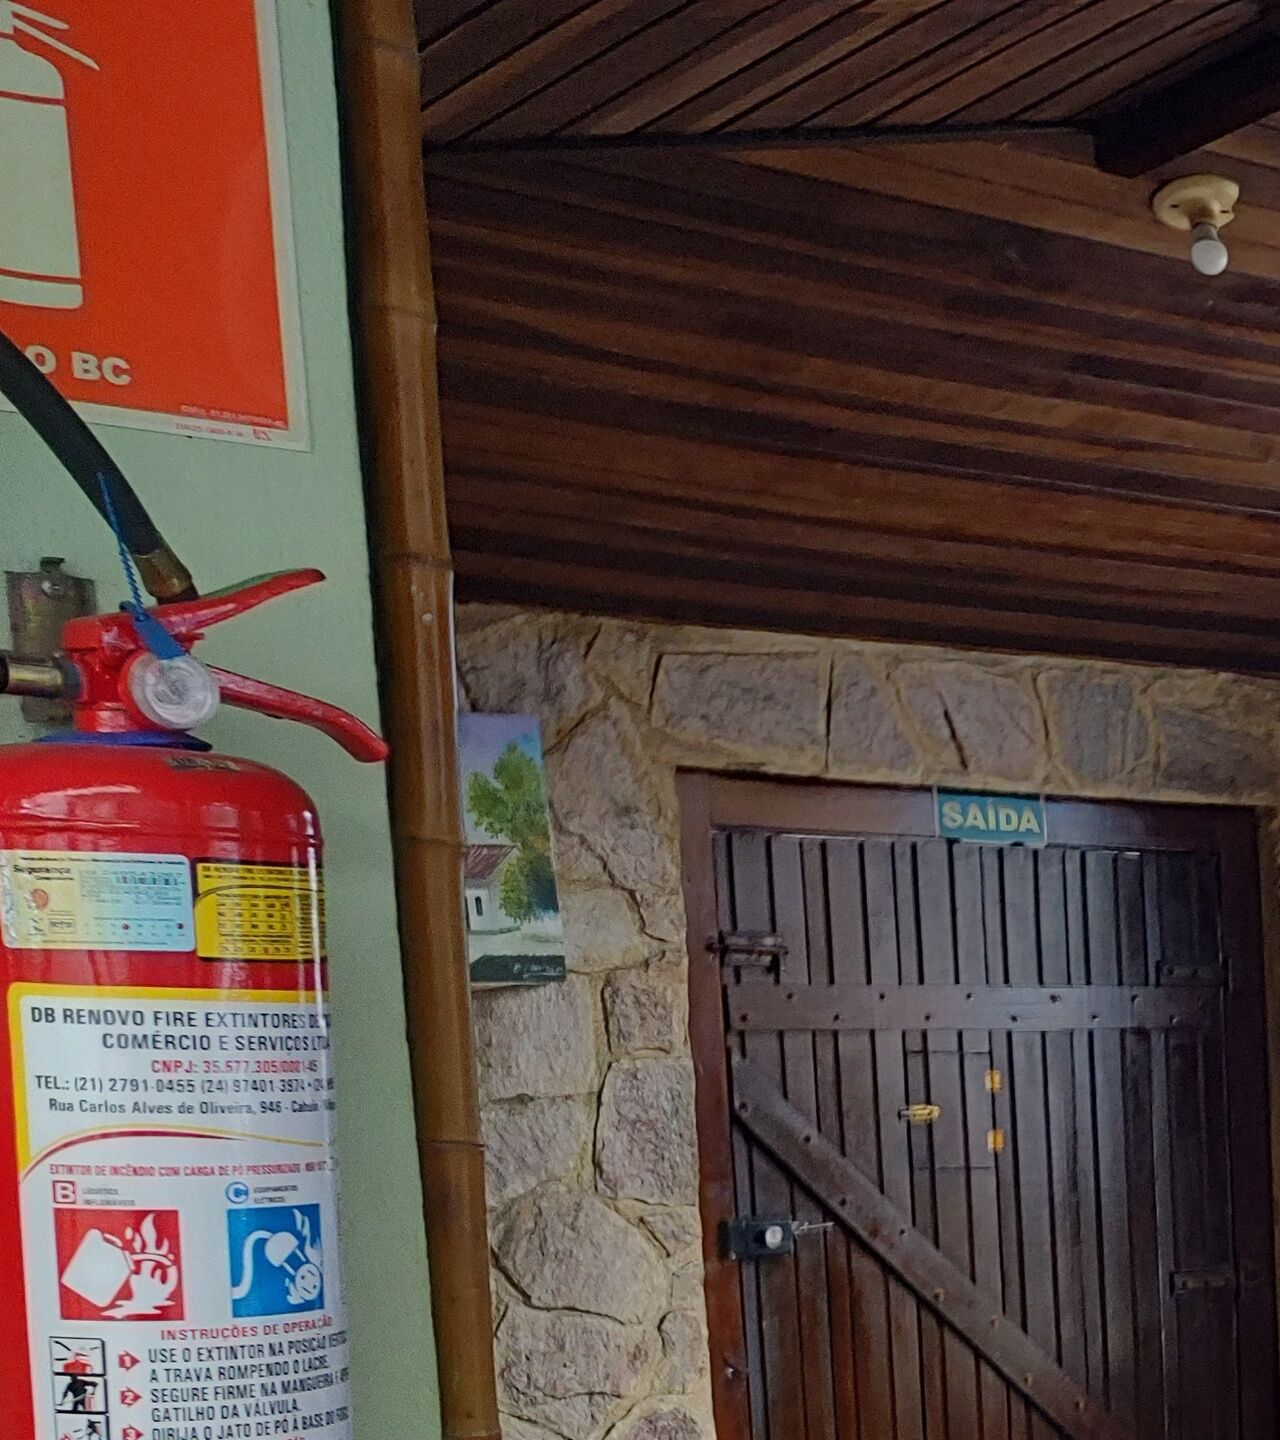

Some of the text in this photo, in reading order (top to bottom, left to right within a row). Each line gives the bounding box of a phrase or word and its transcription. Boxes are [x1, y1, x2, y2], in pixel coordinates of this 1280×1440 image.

[24, 344, 132, 386] O BC
[31, 1006, 56, 1024] DB
[63, 1008, 145, 1026] RENOVO
[154, 1010, 198, 1028] FIRE
[205, 1012, 306, 1029] EXTINTORES
[102, 1030, 211, 1051] COMÉRCIO
[219, 1035, 229, 1051] E
[151, 1059, 198, 1074] CNPJ:
[35, 1075, 70, 1090] TEL.:
[74, 1076, 103, 1093] (21)
[109, 1078, 196, 1093] 2791-0455
[201, 1079, 228, 1094] (24)
[49, 1098, 74, 1112] Rua
[79, 1099, 126, 1114] Carlos
[131, 1101, 173, 1114] Alves
[177, 1102, 194, 1114] de
[95, 1165, 107, 1176] DE
[54, 1182, 76, 1203] B
[161, 1324, 258, 1342] INSTRUÇÕES
[263, 1323, 280, 1336] DE
[148, 1348, 177, 1363] USE
[182, 1347, 192, 1362] O
[197, 1344, 265, 1362] EXTINTOR
[268, 1341, 285, 1357] NA
[149, 1368, 159, 1383] A
[163, 1367, 213, 1383] TRAVA
[218, 1360, 290, 1381] ROMPENDO
[293, 1359, 300, 1375] O
[150, 1386, 209, 1403] SEGURE
[214, 1383, 256, 1401] FIRME
[260, 1382, 278, 1398] NA
[152, 1405, 215, 1423] GATILHO
[221, 1404, 240, 1420] DA
[203, 1425, 212, 1440] O
[217, 1423, 251, 1440] JATO
[256, 1421, 271, 1437] DE
[274, 1415, 289, 1434] PÓ
[302, 1412, 325, 1431] BASE
